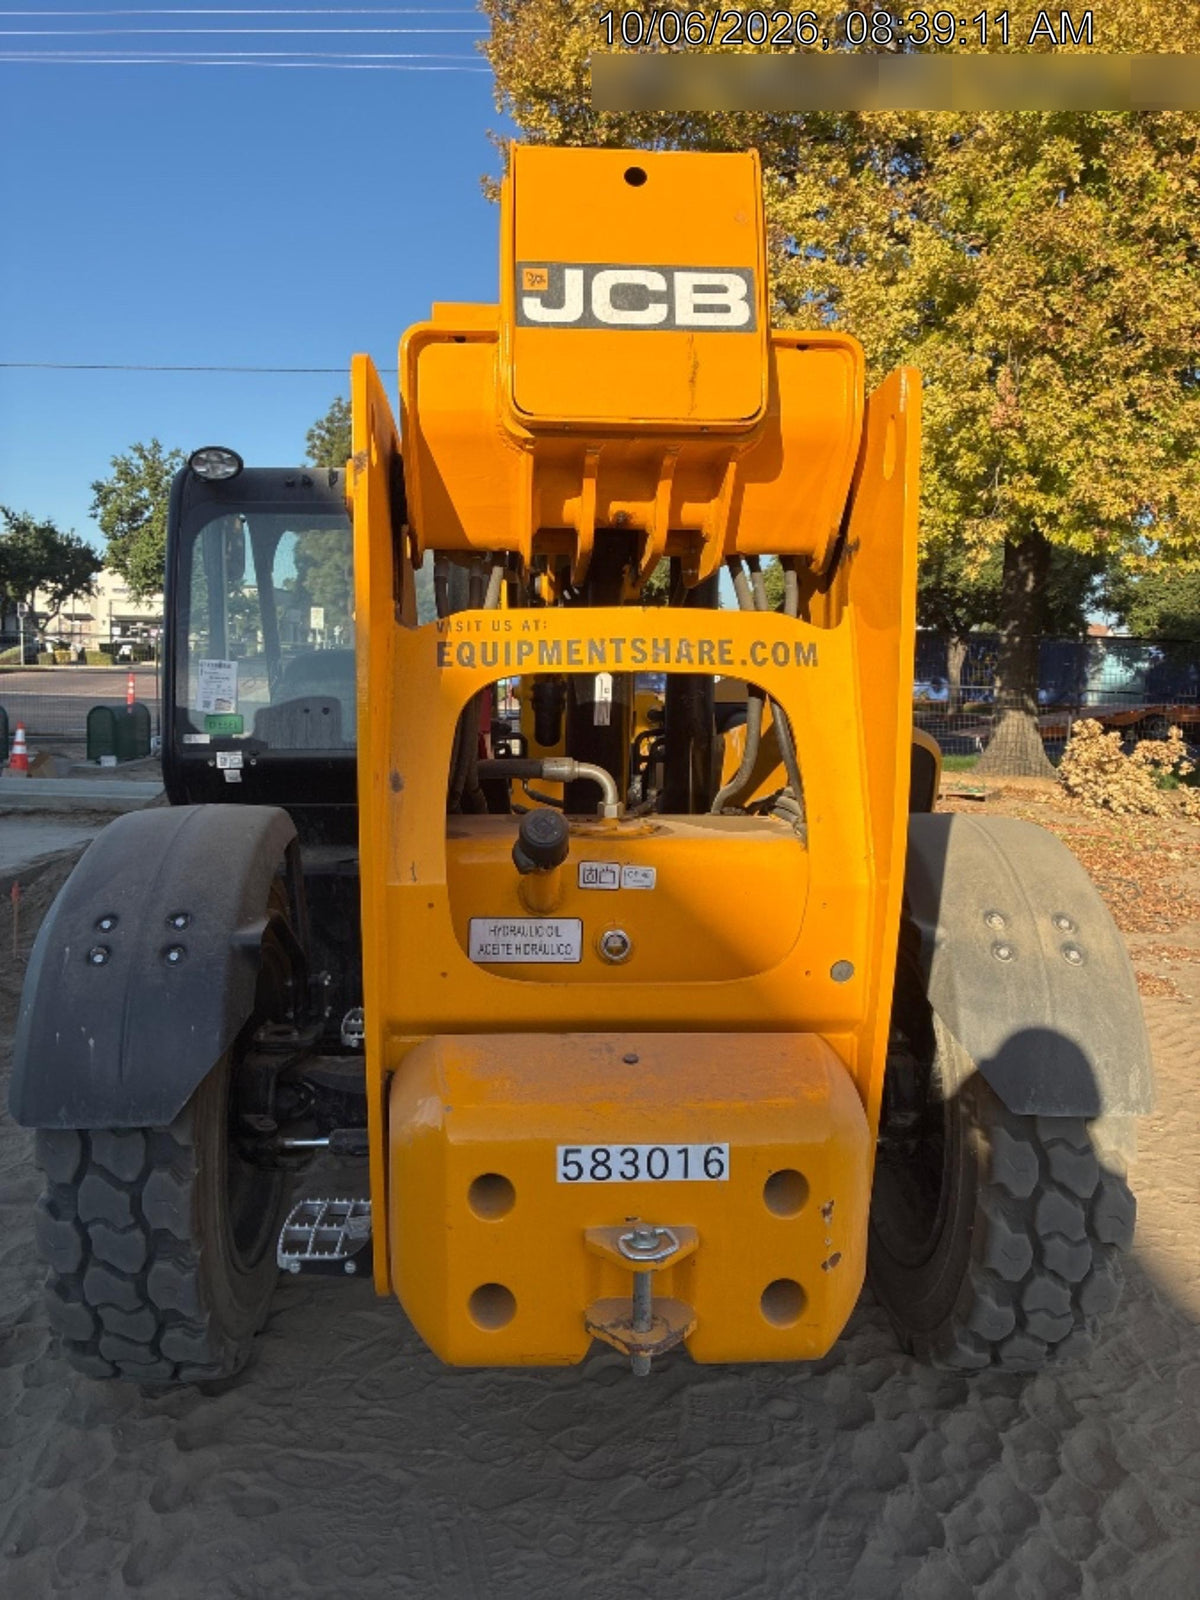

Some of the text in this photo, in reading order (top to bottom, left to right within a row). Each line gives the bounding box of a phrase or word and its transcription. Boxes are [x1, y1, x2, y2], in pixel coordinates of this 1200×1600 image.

[522, 268, 750, 326] JCB
[436, 619, 547, 633] VISIT US AT:
[436, 638, 819, 668] EQUIPMENTSHARE.COM
[488, 925, 545, 938] HYDRAULIC
[478, 943, 513, 956] ACEITE
[562, 1146, 725, 1181] 583016
